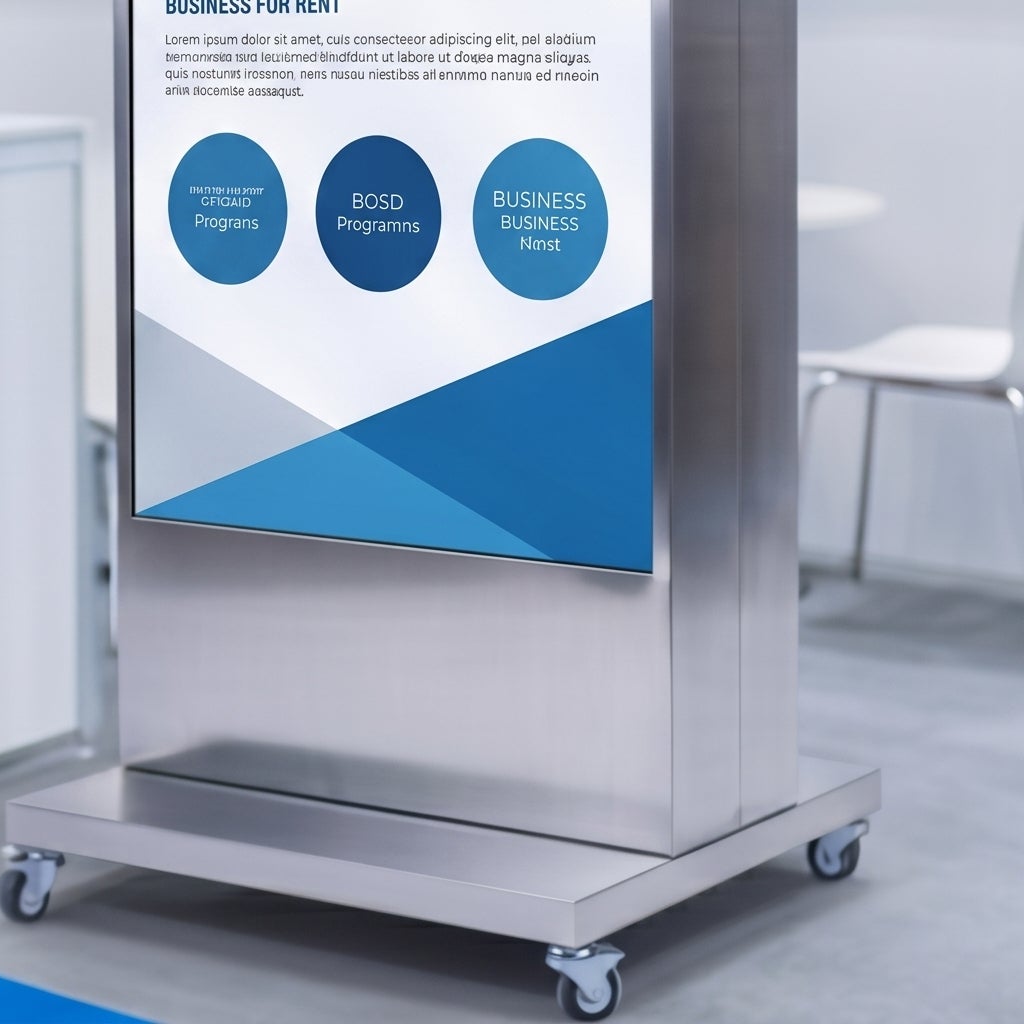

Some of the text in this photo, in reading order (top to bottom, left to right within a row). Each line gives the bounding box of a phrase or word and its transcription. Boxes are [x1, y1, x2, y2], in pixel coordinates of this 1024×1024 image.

[165, 34, 200, 45] Lorem
[203, 33, 238, 47] ipsum
[241, 33, 271, 45] dolor
[274, 33, 288, 45] sit
[290, 34, 324, 47] amet,
[429, 33, 492, 48] adipiscing
[495, 33, 518, 47] elit,
[382, 52, 395, 63] ut
[397, 51, 435, 63] labore
[438, 52, 451, 63] ut
[497, 53, 542, 66] magna
[165, 68, 189, 81] quis
[536, 69, 551, 81] ed
[352, 193, 404, 210] BOSD
[493, 190, 587, 210] BUSINESS
[195, 214, 259, 232] Prograns
[501, 215, 579, 231] BUSINESS
